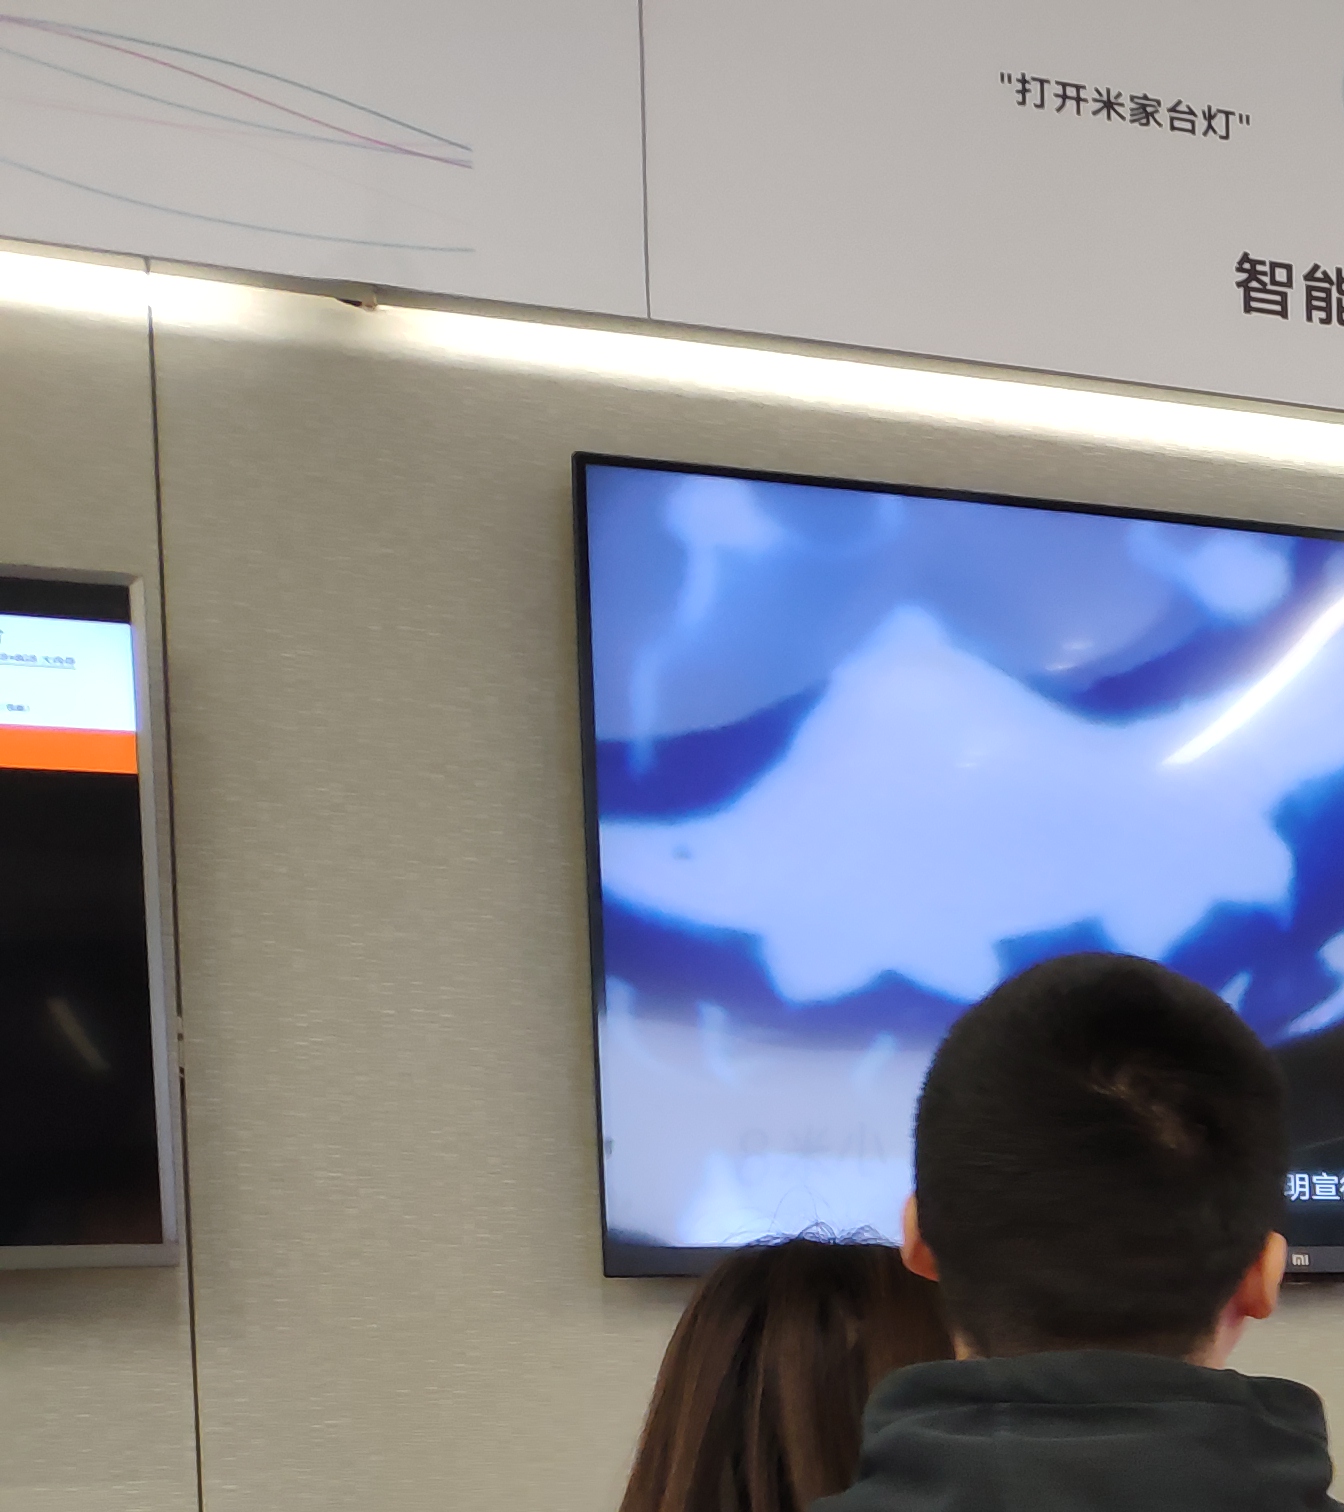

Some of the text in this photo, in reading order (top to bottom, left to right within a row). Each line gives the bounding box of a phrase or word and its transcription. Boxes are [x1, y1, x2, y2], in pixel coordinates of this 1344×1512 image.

[1000, 72, 1251, 141] "打开米家台灯"
